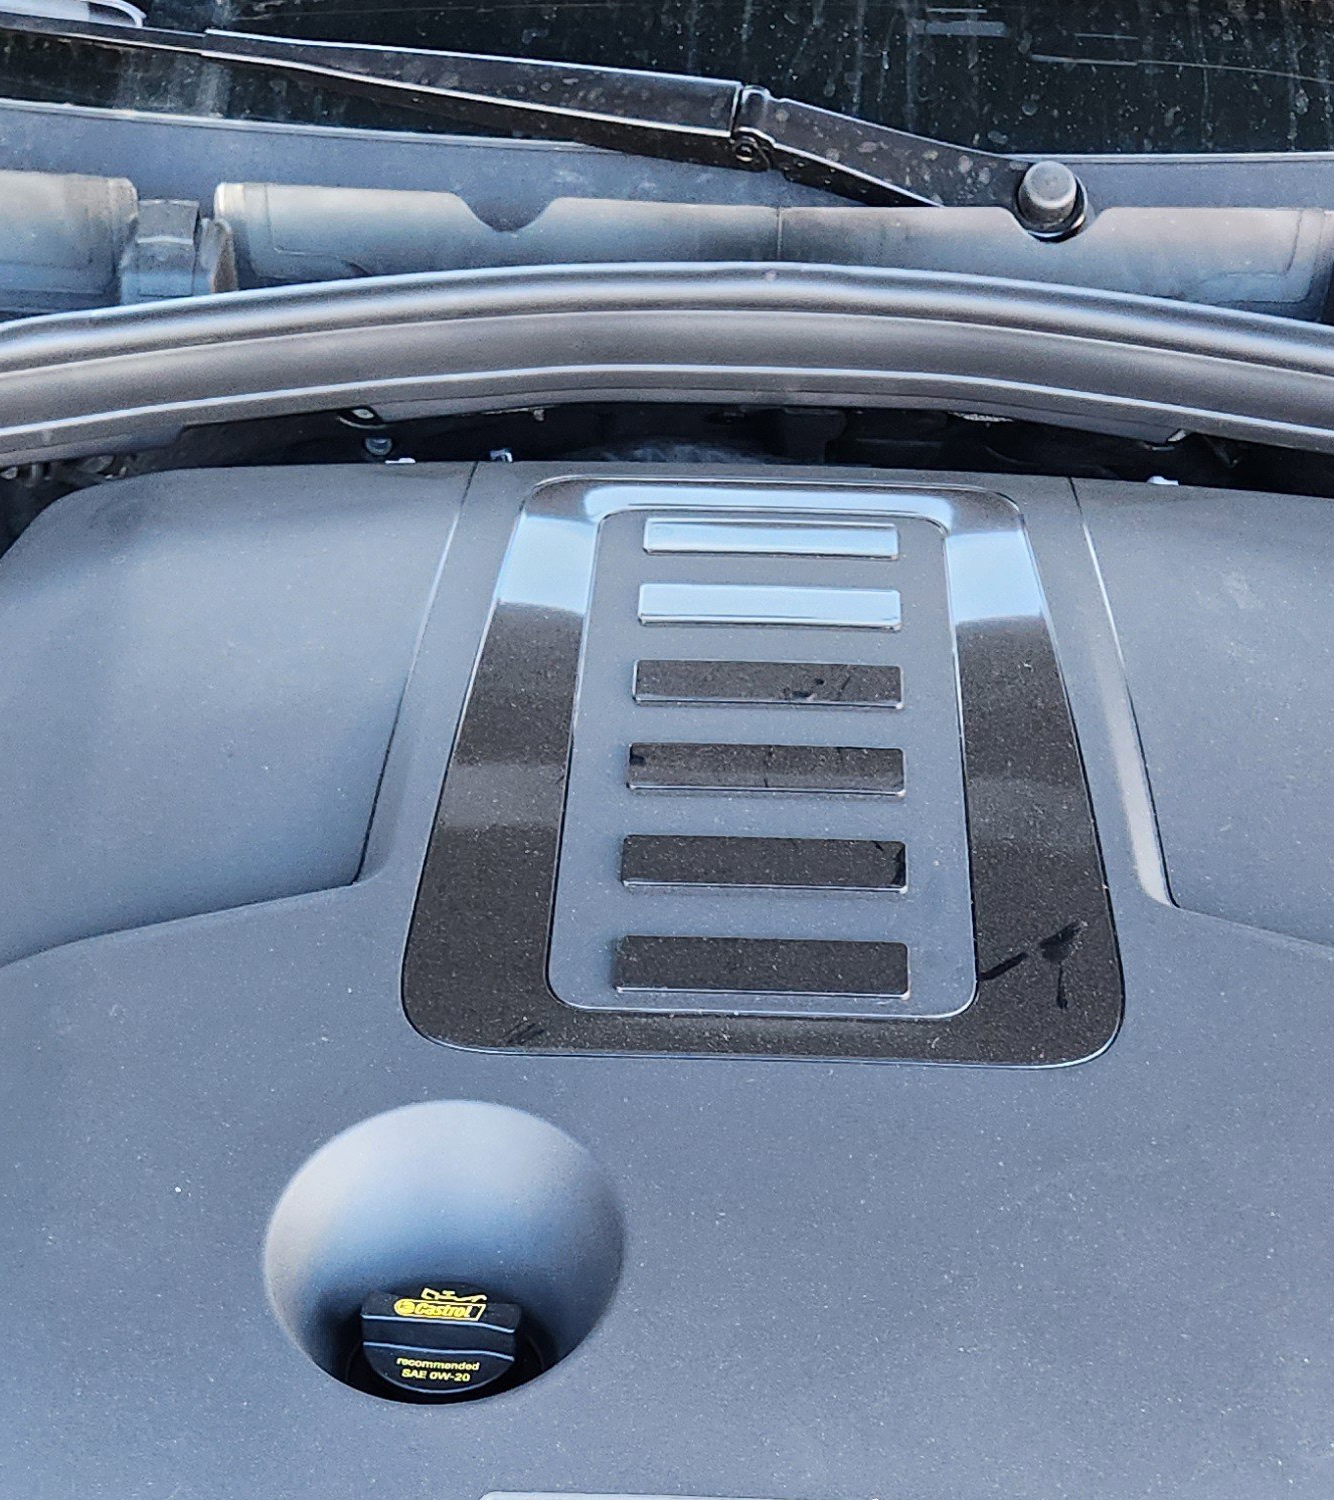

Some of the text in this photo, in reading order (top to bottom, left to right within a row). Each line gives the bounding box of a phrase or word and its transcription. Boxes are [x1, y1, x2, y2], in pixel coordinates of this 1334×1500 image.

[415, 1303, 473, 1318] Castrol
[396, 1358, 480, 1371] recommended
[402, 1369, 471, 1382] SAE 0W-20
